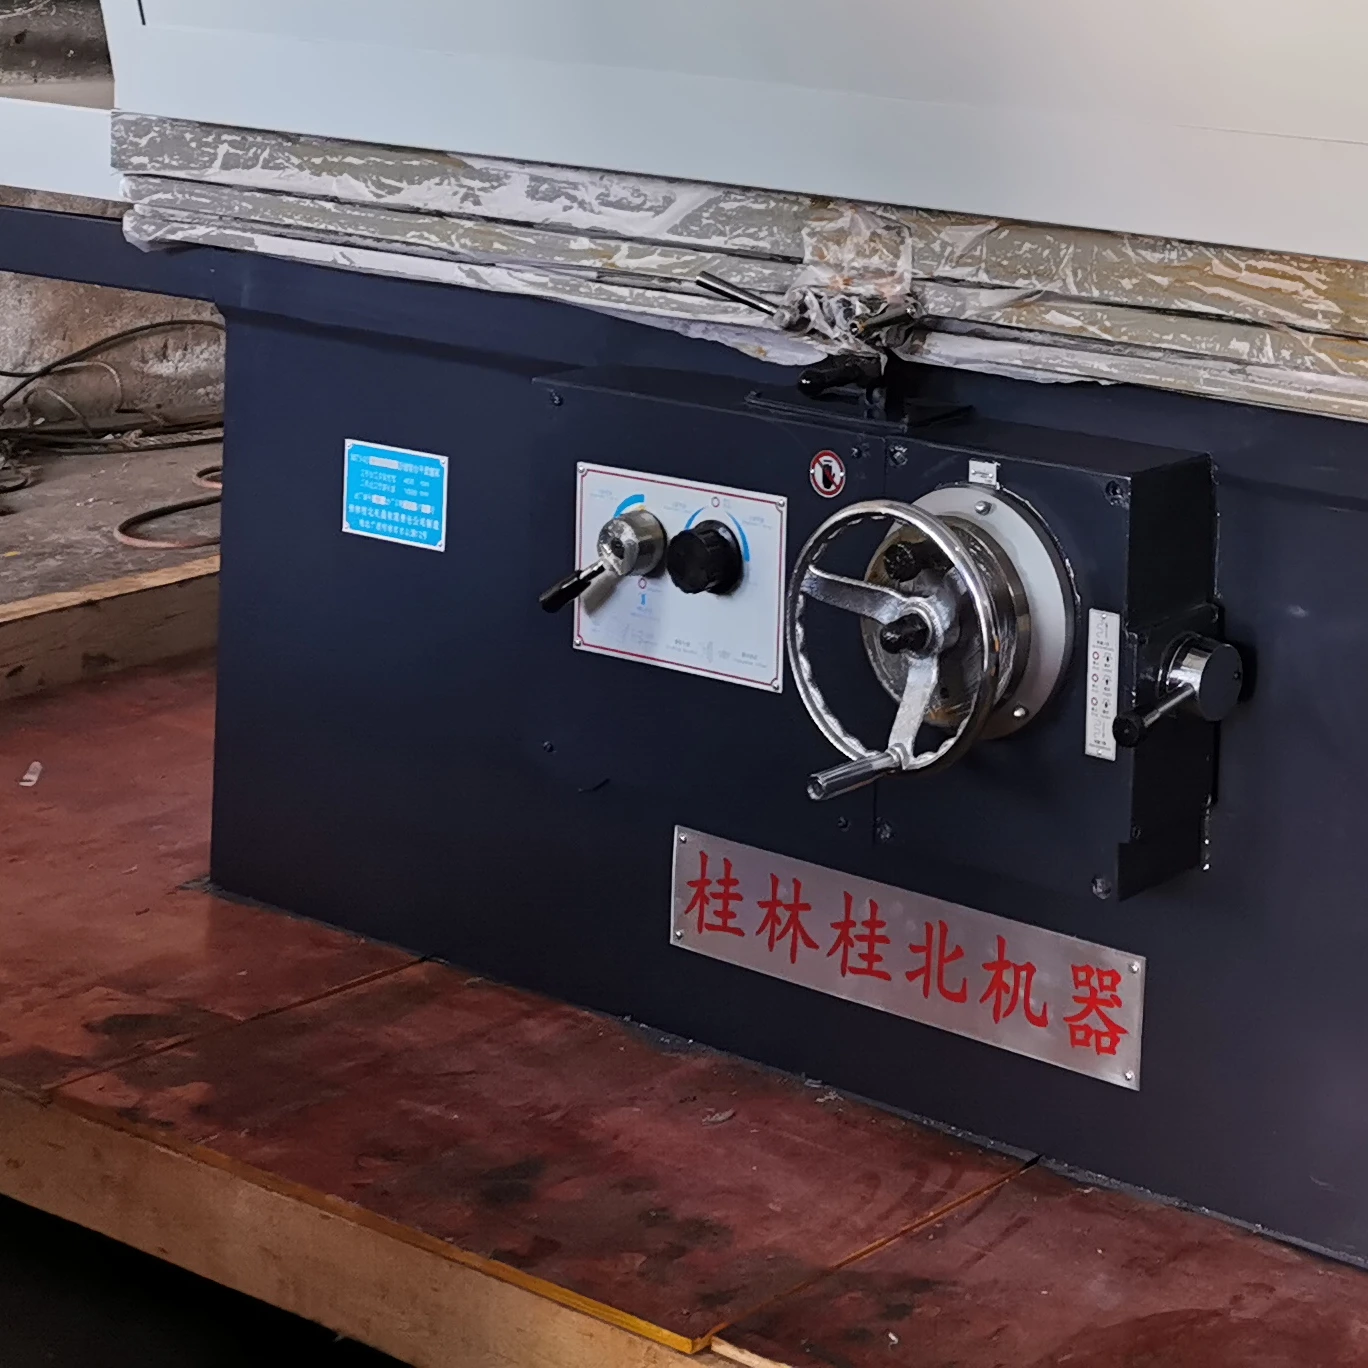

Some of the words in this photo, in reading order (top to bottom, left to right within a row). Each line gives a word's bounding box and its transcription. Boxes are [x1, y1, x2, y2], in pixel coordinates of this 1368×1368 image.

[684, 850, 1129, 1056] 桂林桂北机器
